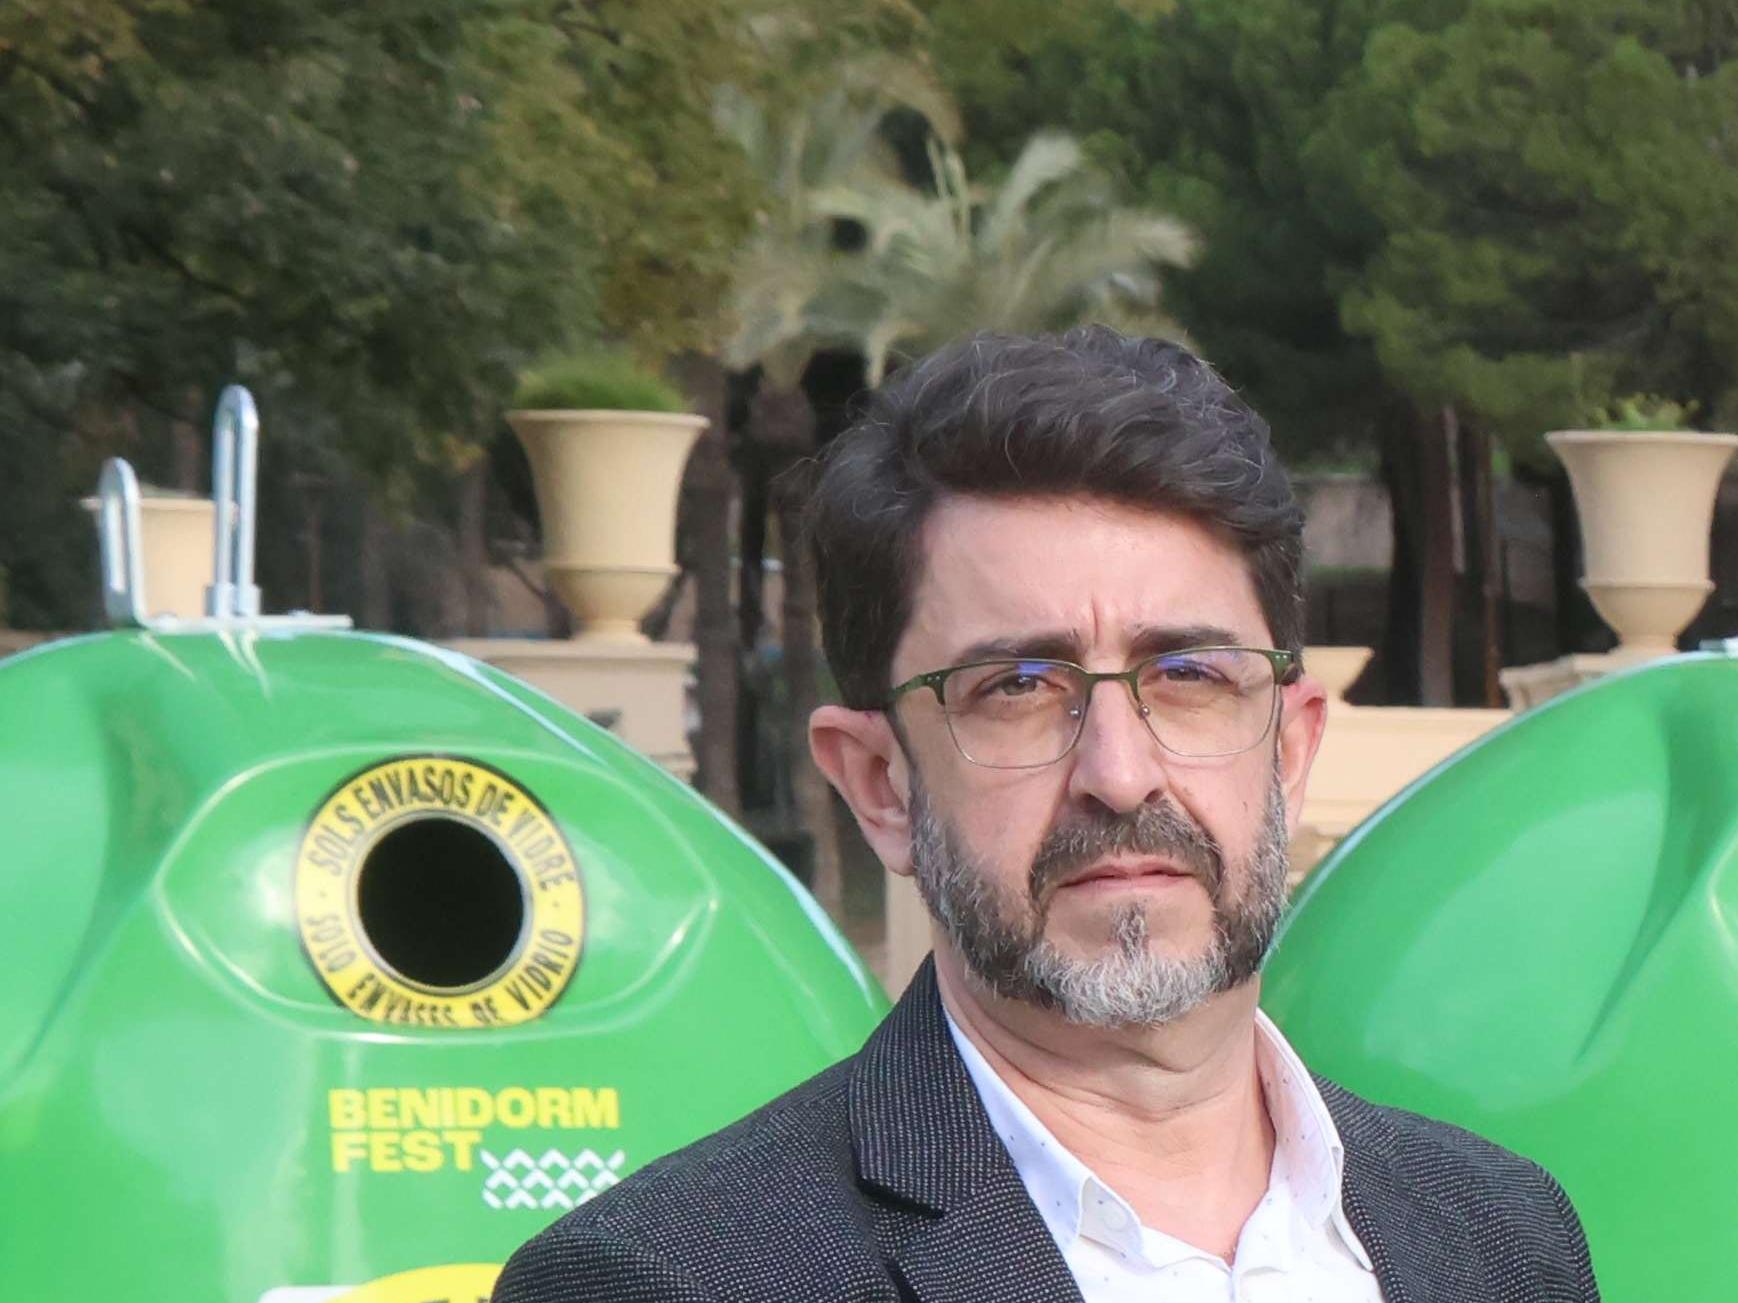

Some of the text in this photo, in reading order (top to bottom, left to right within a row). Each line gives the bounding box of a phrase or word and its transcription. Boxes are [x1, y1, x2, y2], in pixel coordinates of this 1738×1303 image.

[307, 765, 576, 891] SOLS ENVASOS DE VIDRE
[505, 929, 574, 1011] VIDRIO
[328, 1087, 620, 1129] BENIDORM
[330, 1130, 483, 1173] FEST
